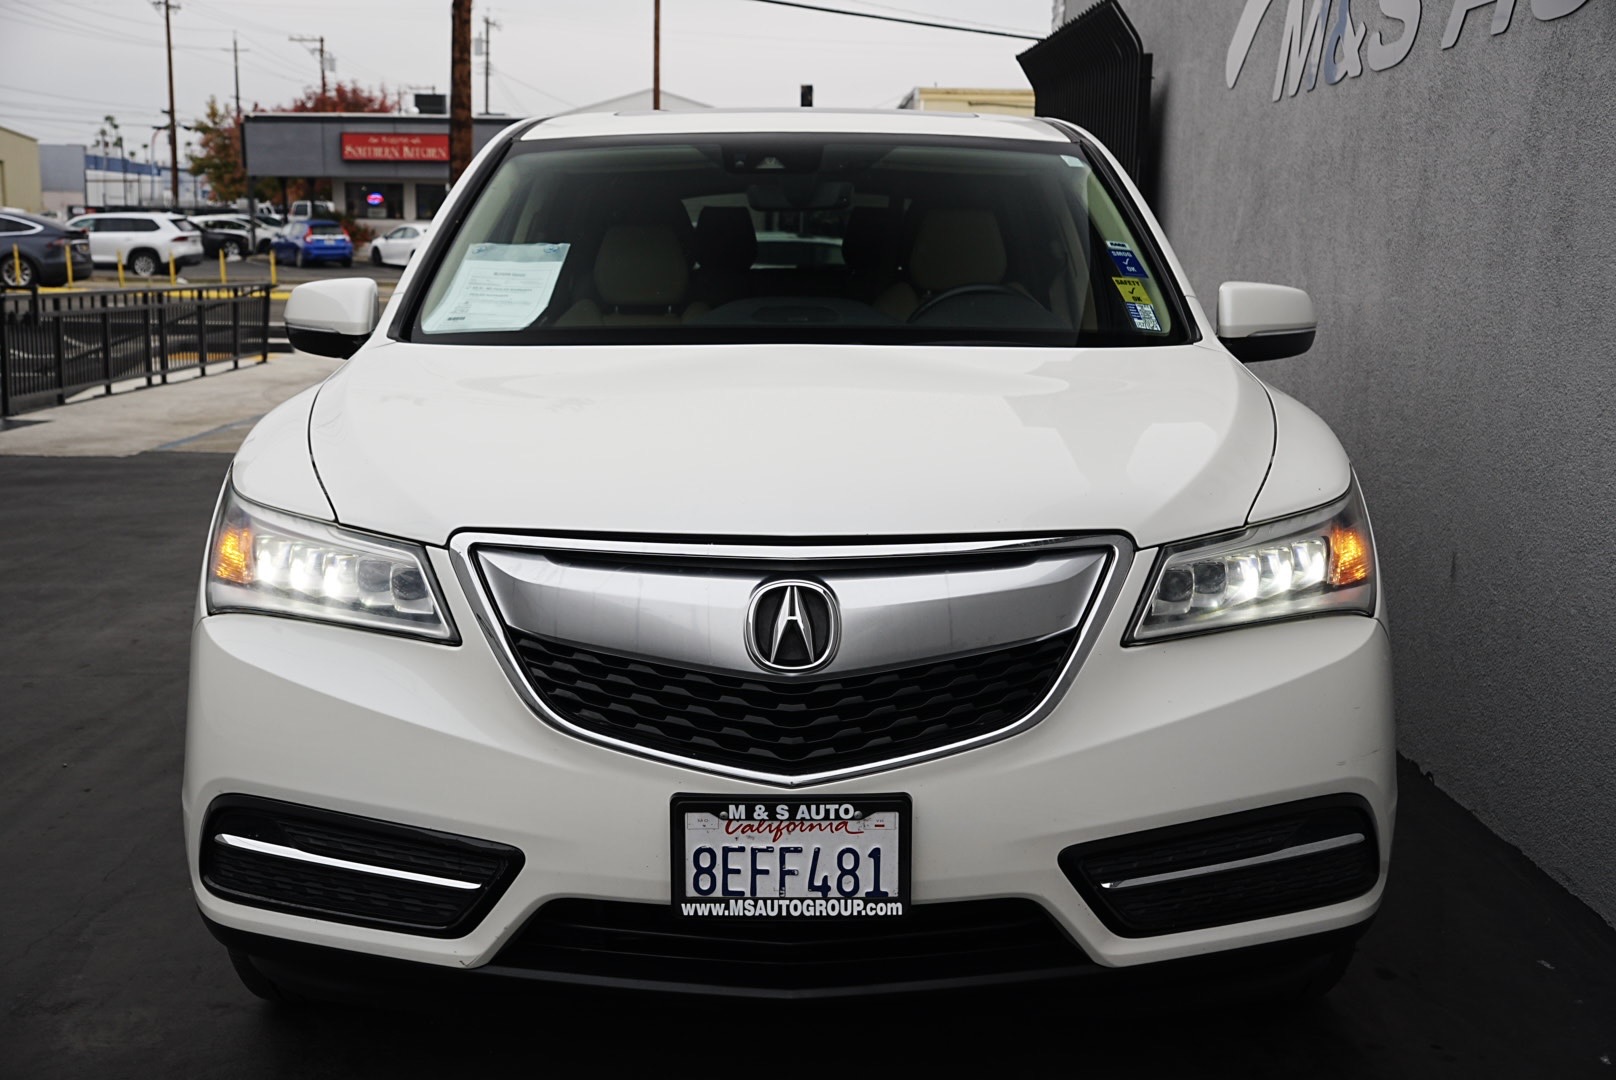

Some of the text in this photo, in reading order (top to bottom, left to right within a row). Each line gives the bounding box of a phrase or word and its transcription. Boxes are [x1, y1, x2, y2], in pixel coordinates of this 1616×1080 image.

[1115, 279, 1140, 287] SAFETY
[728, 803, 855, 820] M & S AUTO
[725, 819, 864, 843] California
[692, 846, 889, 898] 8EFF481
[681, 899, 903, 917] www.MSAUTOGROUP.com
